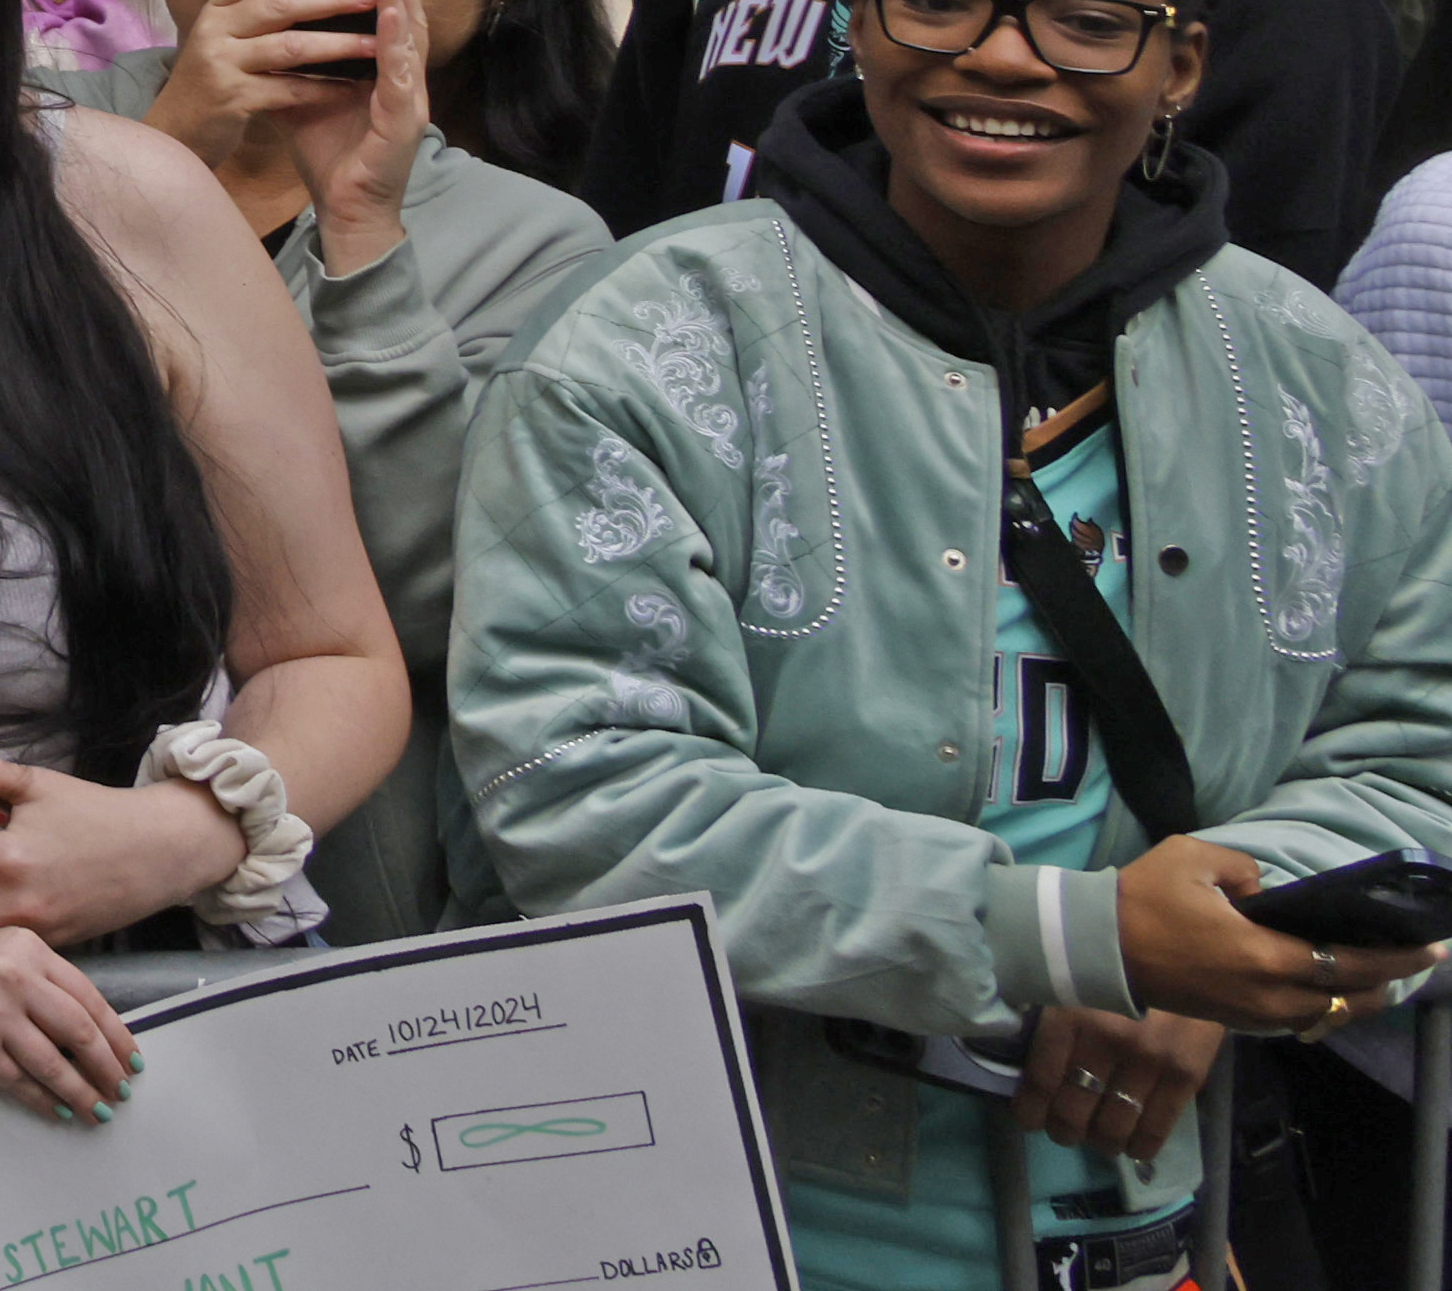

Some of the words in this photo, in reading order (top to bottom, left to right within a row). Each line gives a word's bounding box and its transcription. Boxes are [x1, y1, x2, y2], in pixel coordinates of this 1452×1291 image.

[332, 1039, 381, 1065] DATE
[399, 1123, 422, 1174] $
[2, 1180, 198, 1286] STEWART
[600, 1247, 695, 1281] DOLLARS
